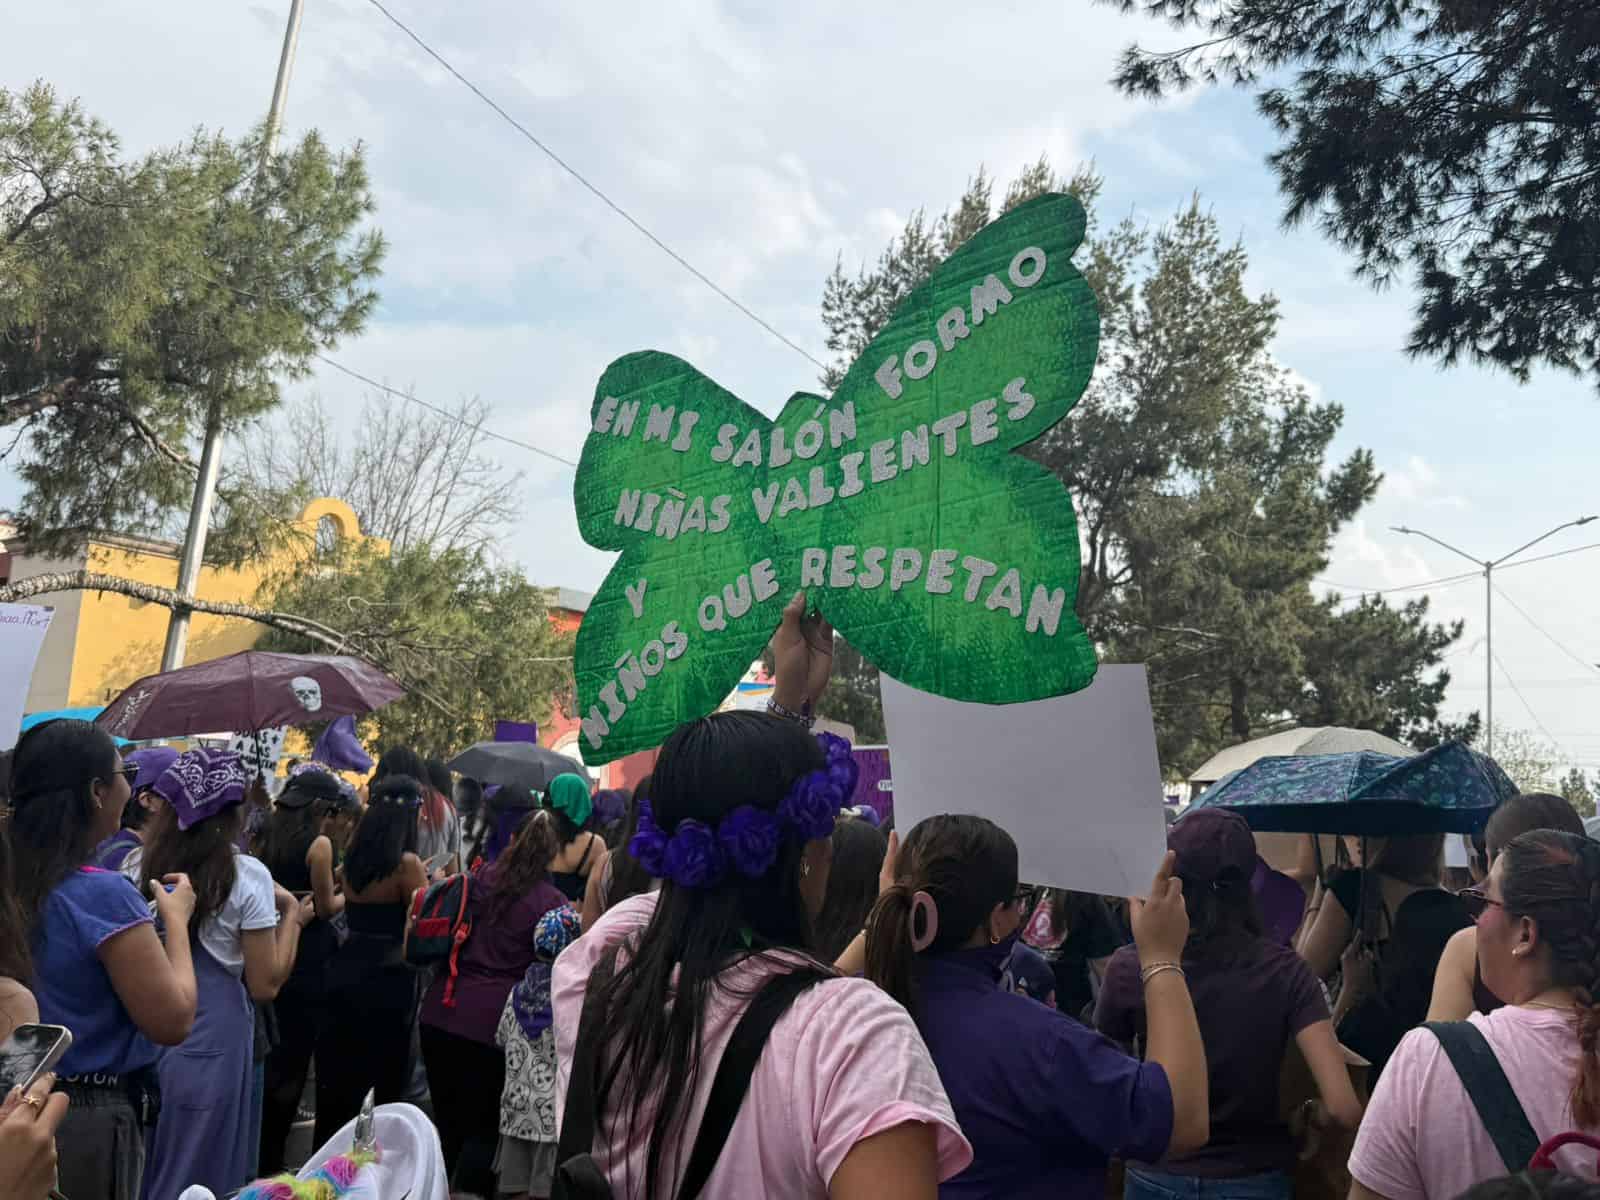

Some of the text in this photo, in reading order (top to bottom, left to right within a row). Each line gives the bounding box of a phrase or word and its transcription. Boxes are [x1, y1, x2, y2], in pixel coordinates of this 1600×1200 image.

[592, 246, 1047, 468] EN MI SALÓN FORMO
[614, 377, 1036, 540] NIÑAS VALIENTES
[581, 546, 1066, 750] NIÑOS QUE RESPETAN
[625, 579, 648, 618] Y
